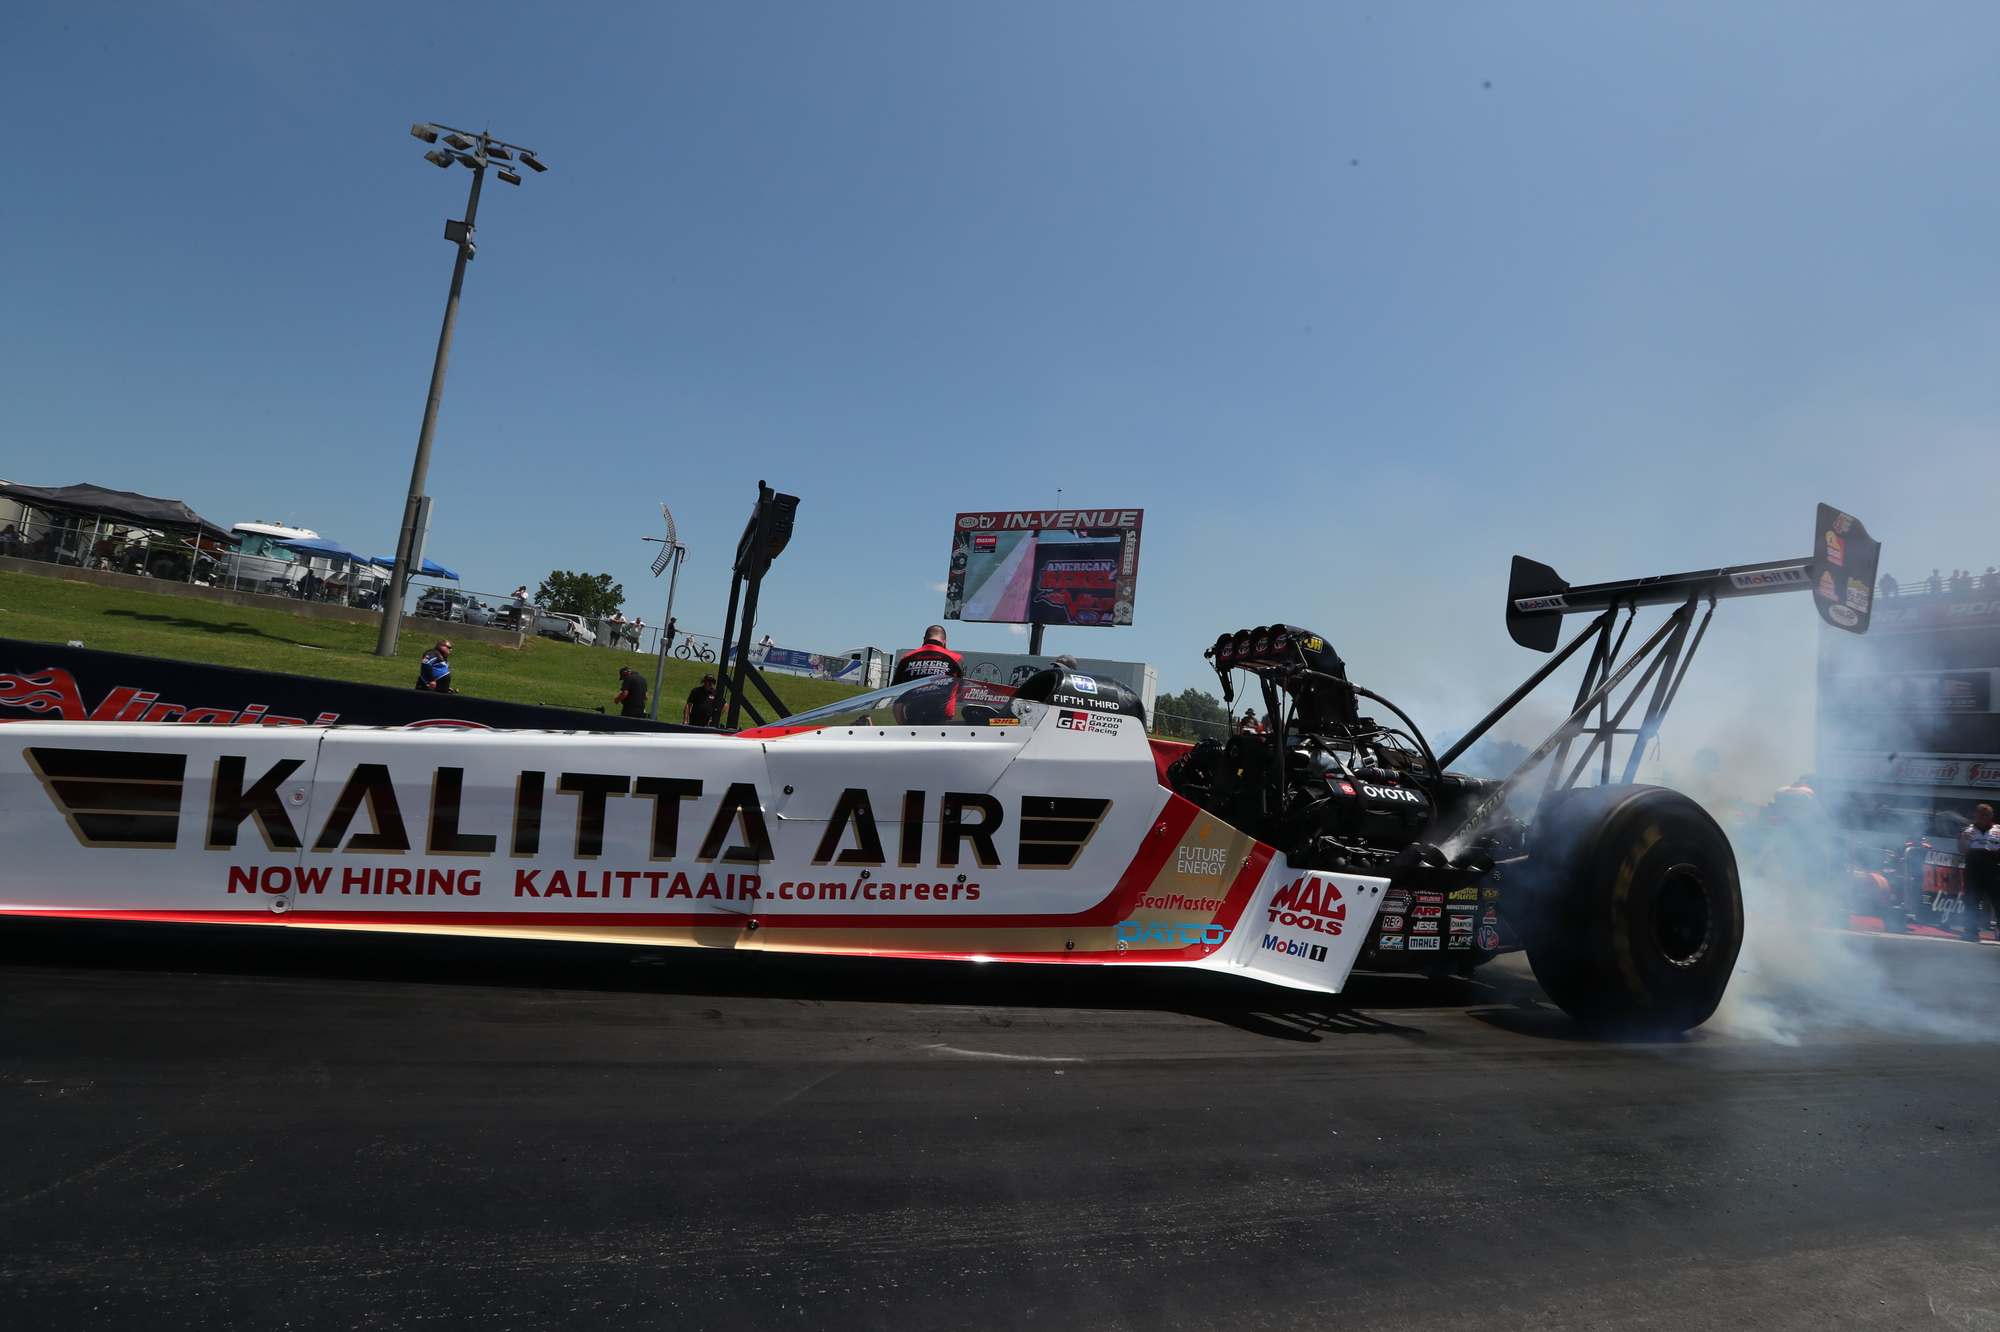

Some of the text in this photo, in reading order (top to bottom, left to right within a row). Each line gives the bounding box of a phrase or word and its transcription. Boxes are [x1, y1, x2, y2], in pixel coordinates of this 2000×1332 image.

[1003, 511, 1139, 529] IN-VENUE
[1046, 562, 1112, 572] AMERICAN
[1041, 571, 1116, 588] REBEL
[1736, 572, 1784, 586] Mobil
[1519, 600, 1550, 610] Mobil
[908, 660, 949, 669] MAKERS
[910, 668, 946, 676] FIXERS
[964, 693, 1010, 703] ILLUSTRATED
[1053, 694, 1120, 710] FIFTH THIRD
[1089, 720, 1119, 729] GAZOO
[1090, 713, 1123, 724] TOYOTA
[1087, 726, 1118, 737] Racing
[1363, 785, 1420, 803] OYOTA
[205, 755, 1004, 869] KALITTA AIR
[1178, 846, 1226, 862] FUTURE
[1925, 850, 1967, 869] AMERIC
[1177, 860, 1225, 876] ENERGY
[227, 866, 981, 902] NOW HIRING KALITTAAIR.com/careers
[1176, 874, 1224, 884] SOLUTIONS
[1923, 864, 1965, 895] REB
[1135, 892, 1222, 911] SealMaster
[1267, 877, 1347, 921] MAC
[1932, 889, 1965, 923] ligh
[1414, 906, 1441, 916] ARP
[1267, 909, 1343, 936] TOOLS
[1413, 921, 1439, 931] JESEL
[1113, 921, 1232, 945] DAYCO
[1262, 934, 1308, 958] Mobil
[1410, 939, 1438, 948] MAHLE
